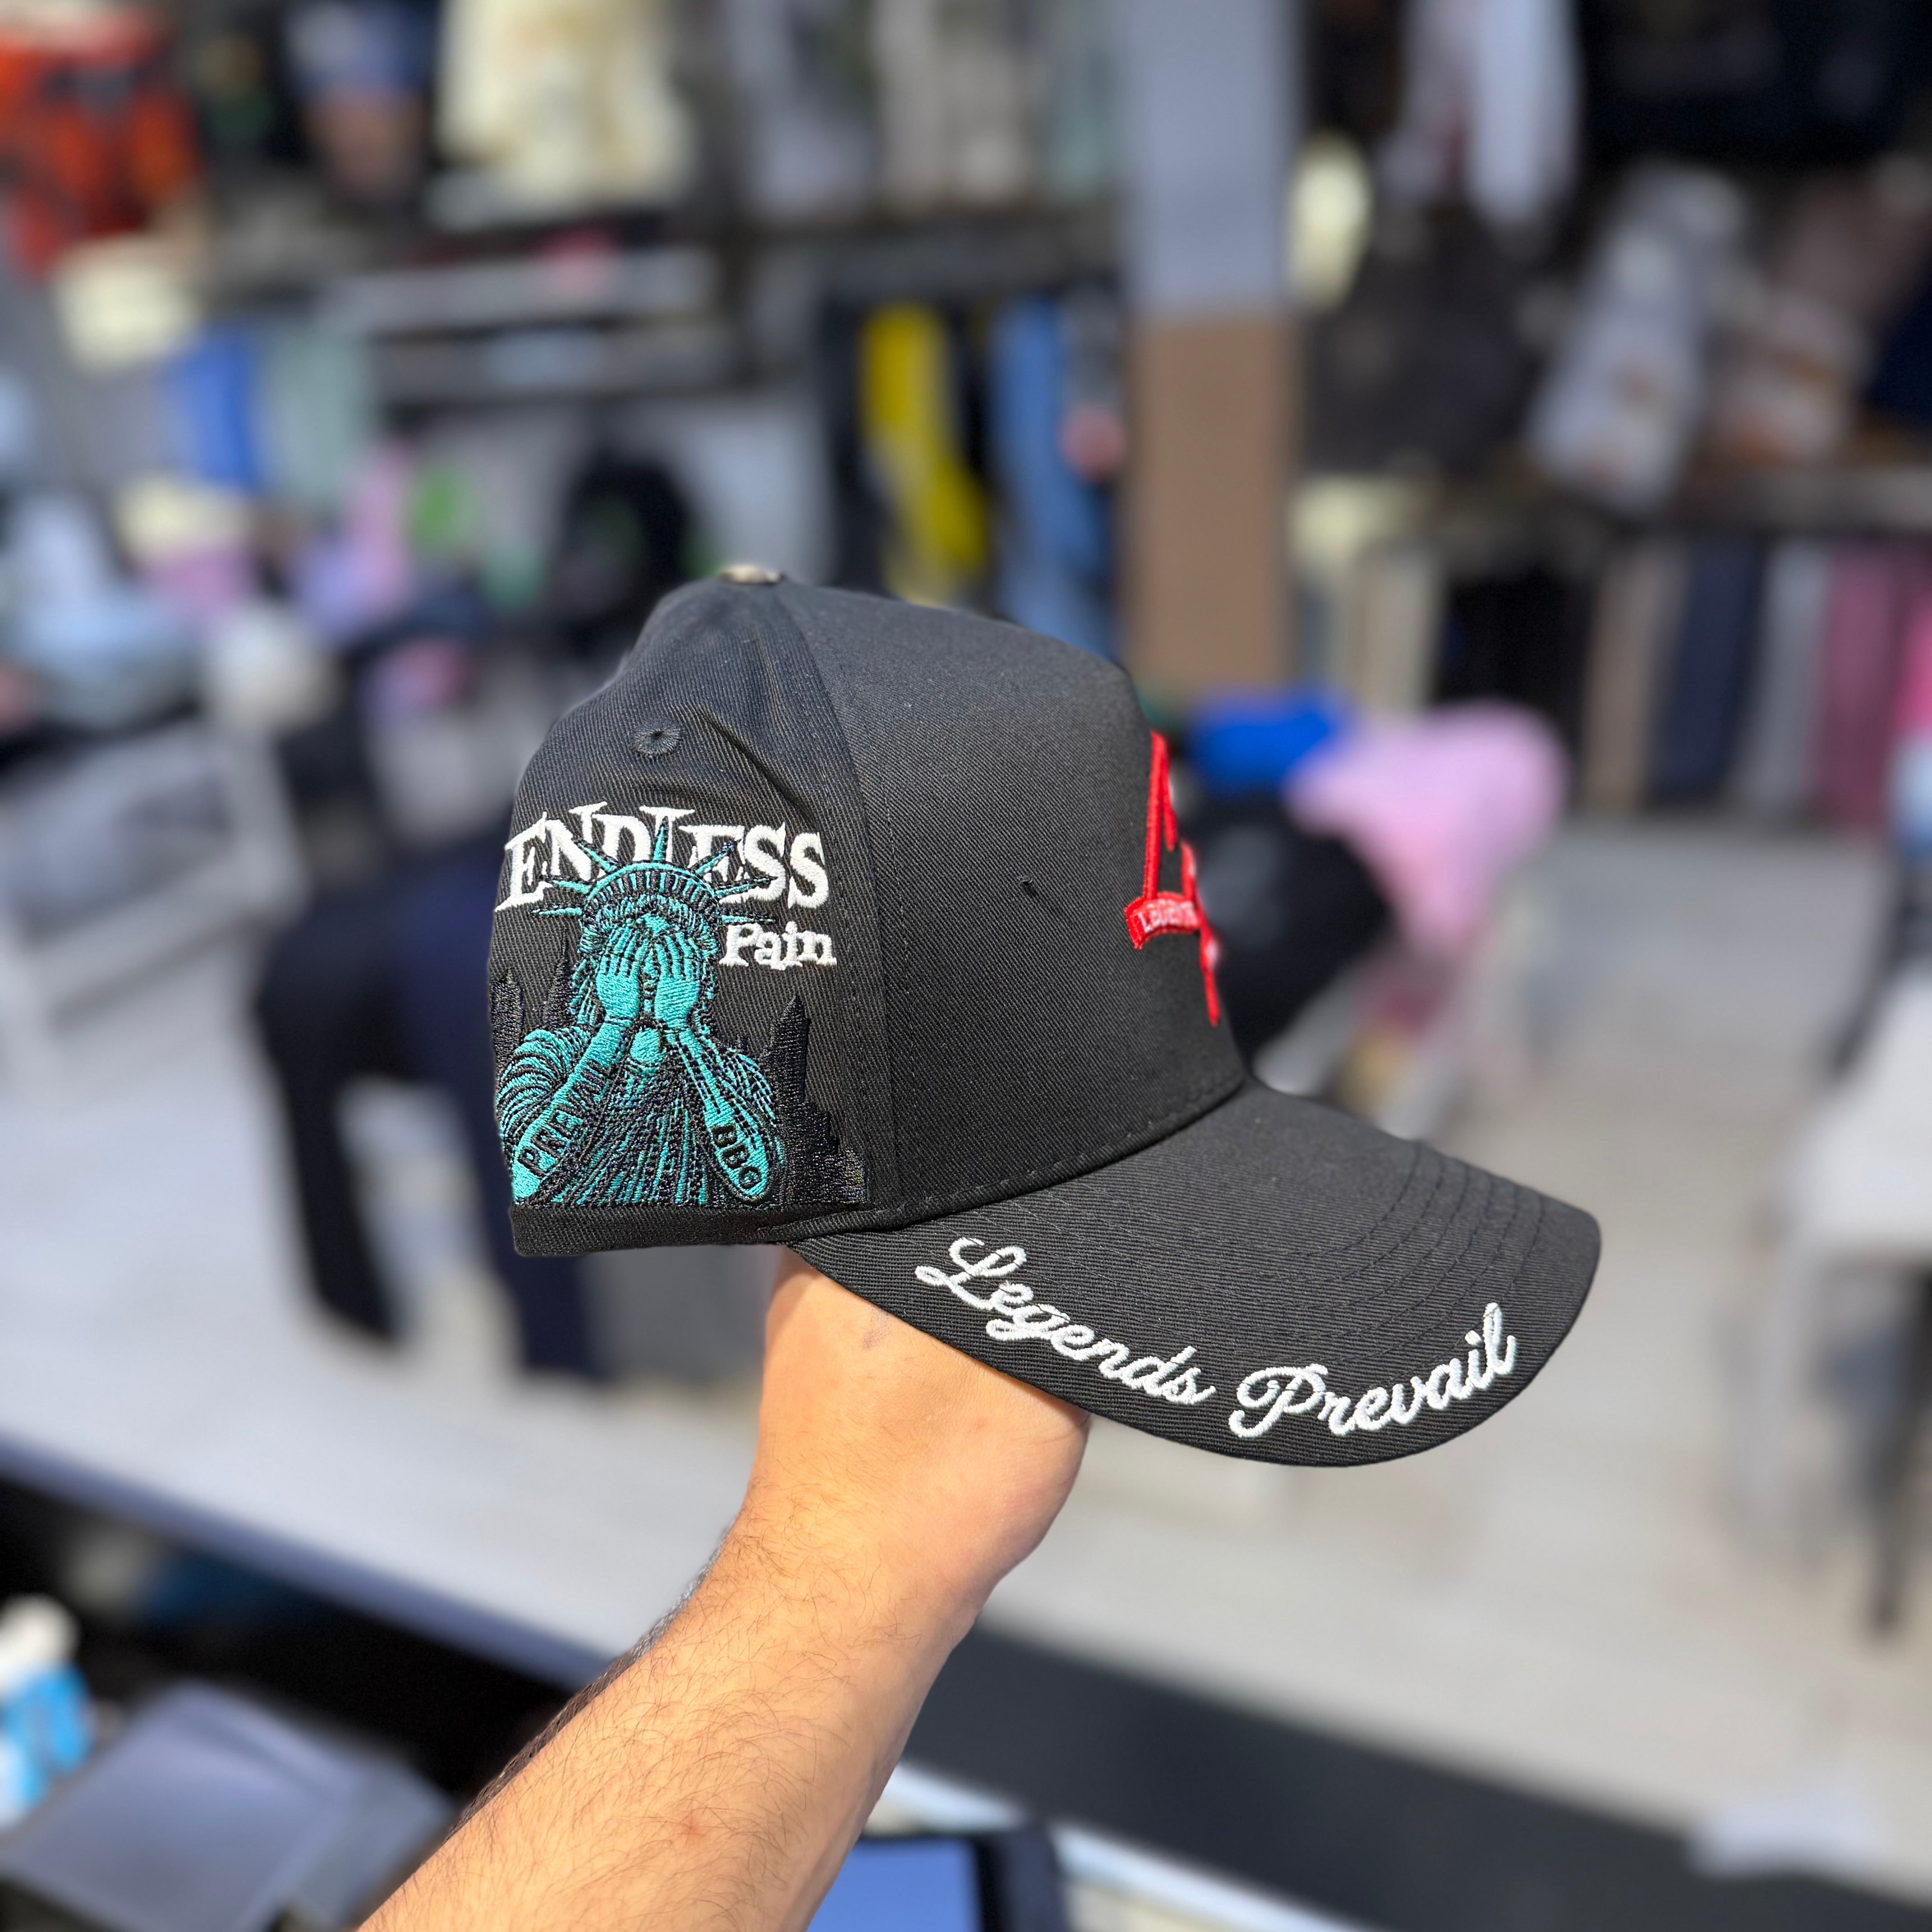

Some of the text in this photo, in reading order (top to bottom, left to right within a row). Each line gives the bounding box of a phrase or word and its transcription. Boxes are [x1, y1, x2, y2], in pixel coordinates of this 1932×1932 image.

[719, 921, 837, 970] Pain
[518, 1060, 607, 1175] PREVAIL
[915, 1238, 1515, 1438] Legends Prevail
